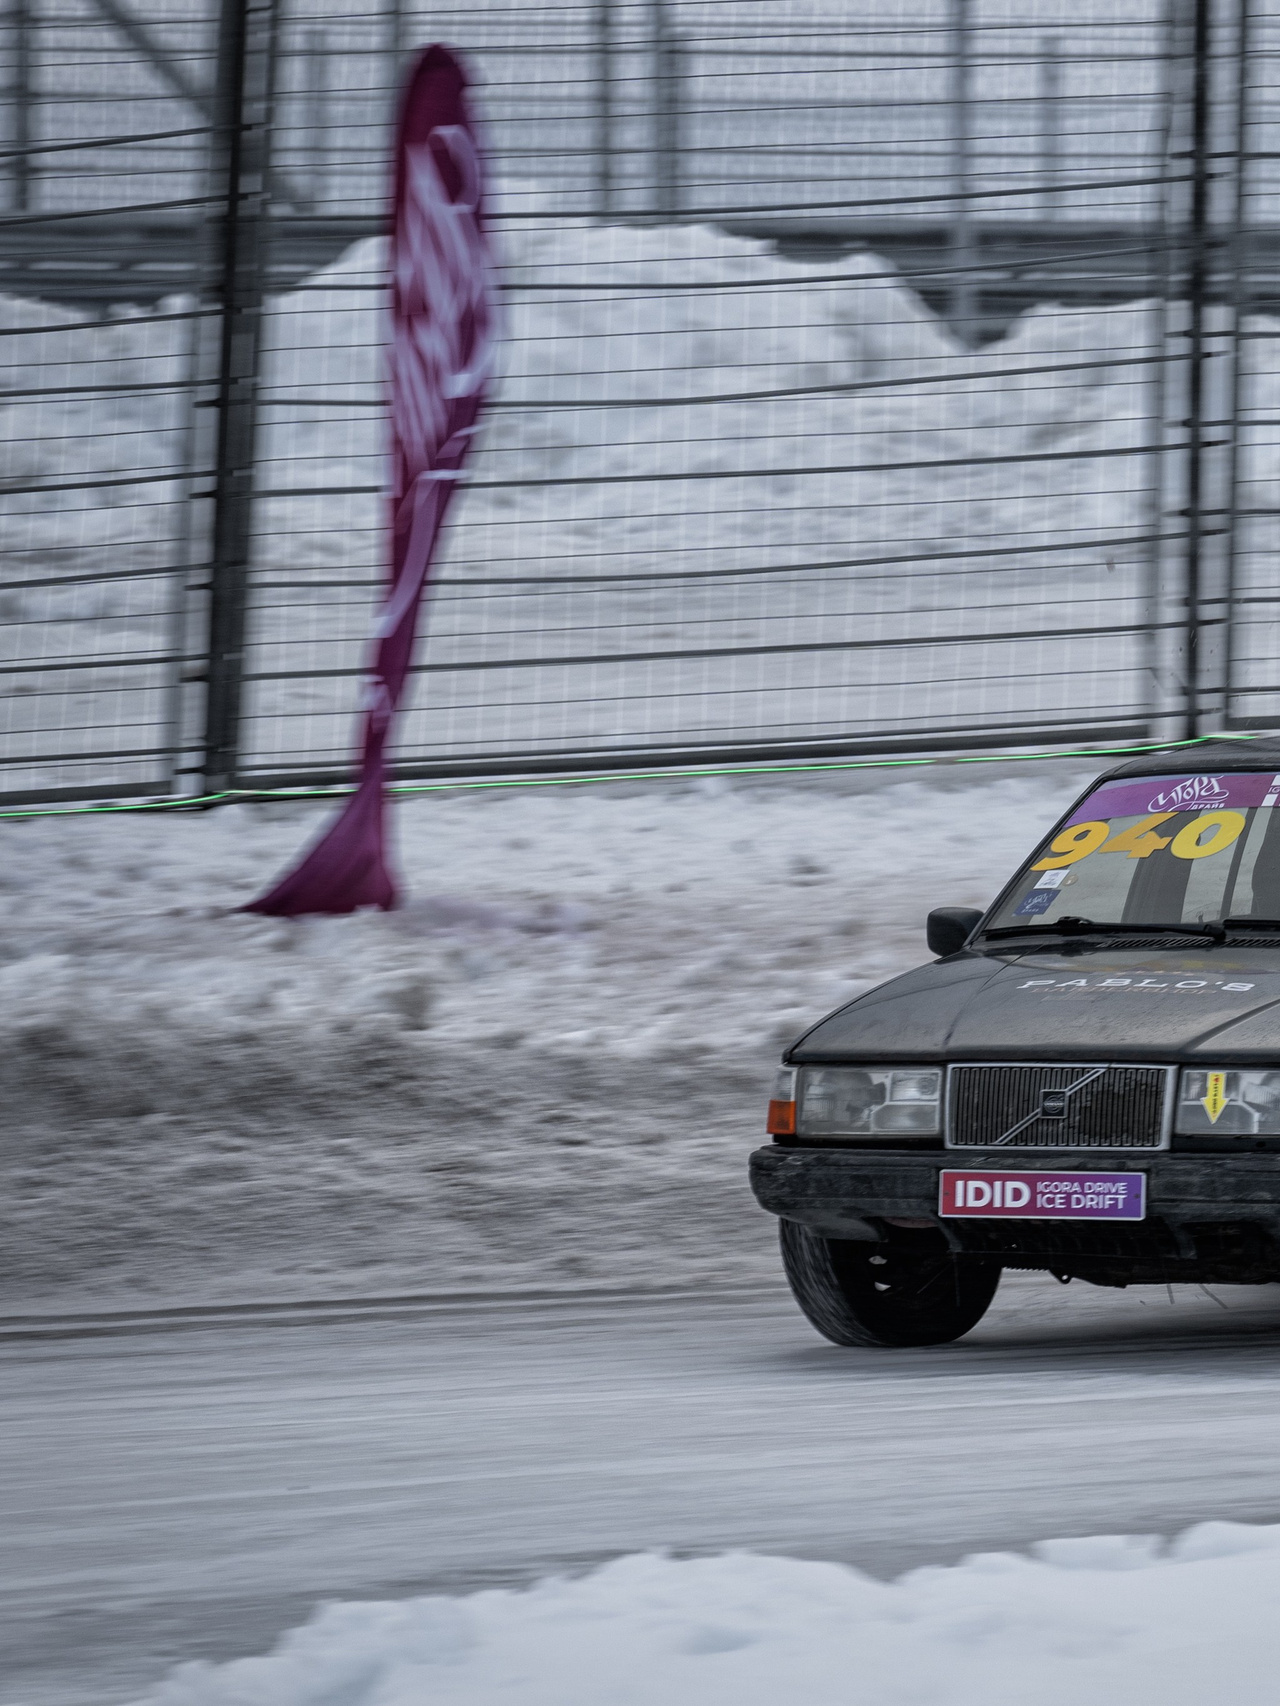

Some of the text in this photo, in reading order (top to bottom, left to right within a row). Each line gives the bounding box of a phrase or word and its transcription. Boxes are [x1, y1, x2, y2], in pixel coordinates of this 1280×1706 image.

[1029, 810, 1246, 871] 940
[1016, 978, 1256, 992] PABLO'S
[954, 1180, 1031, 1208] IDID
[1036, 1181, 1128, 1194] IGORA DRIVE
[1036, 1193, 1128, 1209] ICE DRIFT
